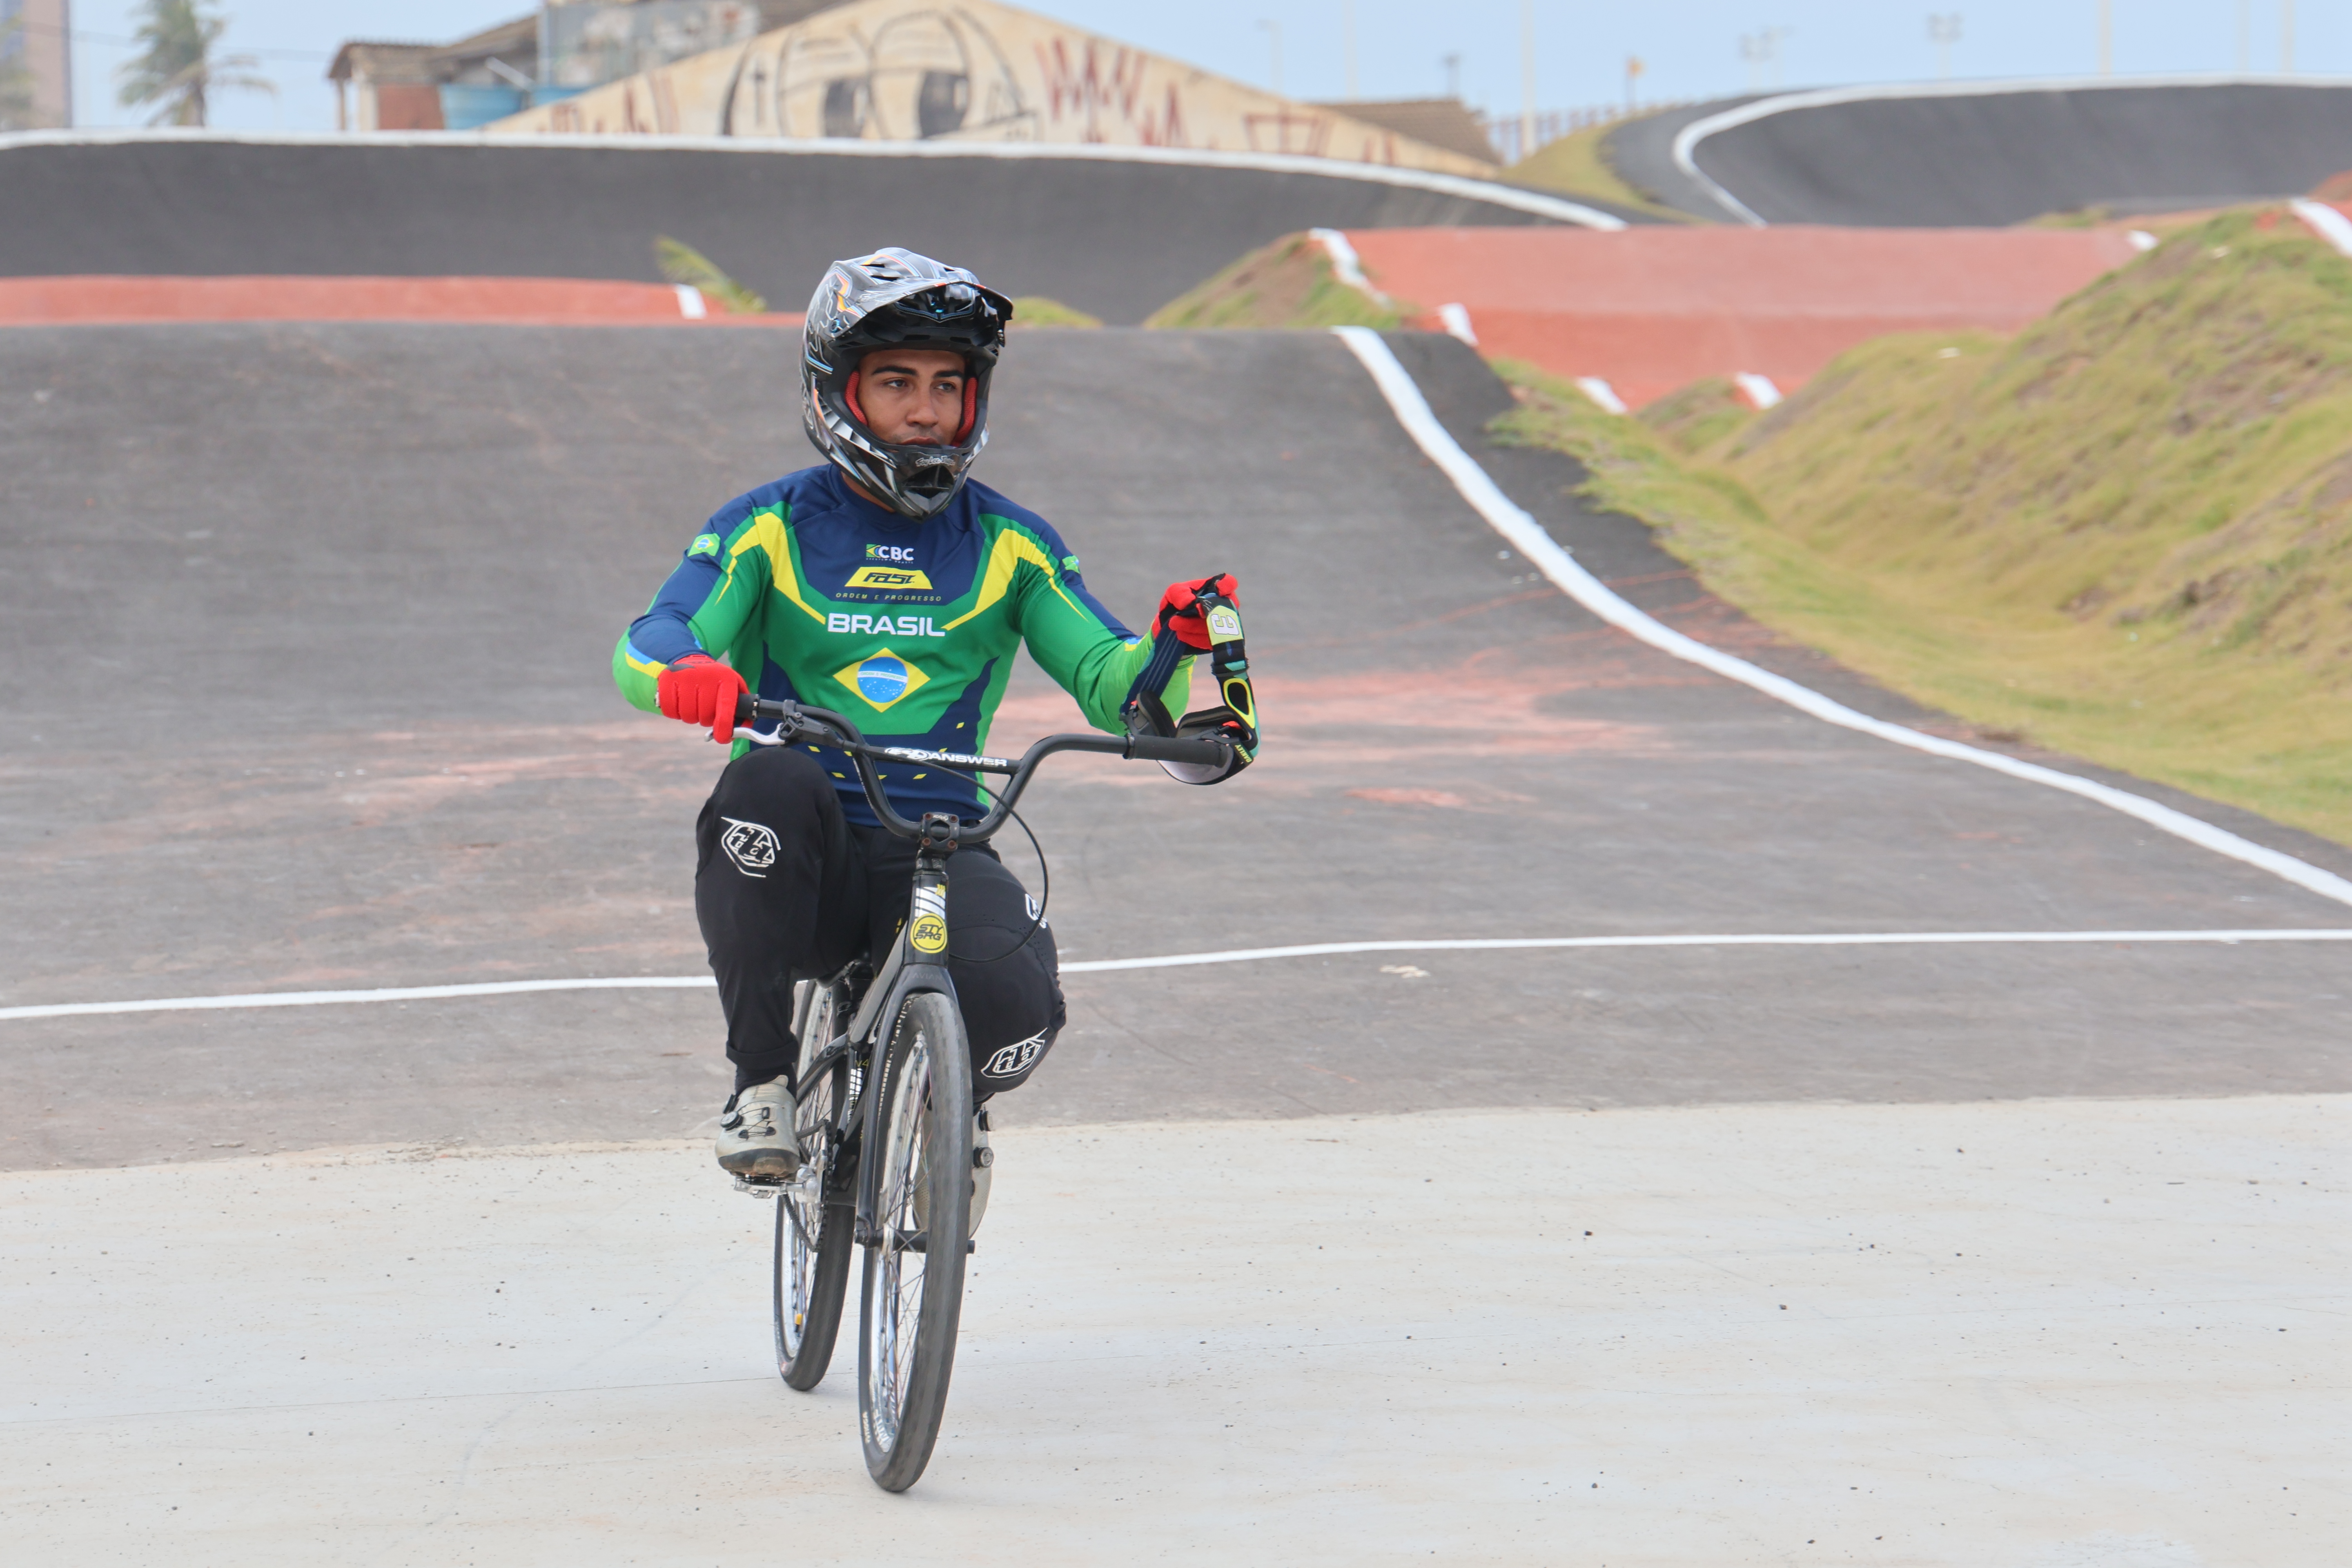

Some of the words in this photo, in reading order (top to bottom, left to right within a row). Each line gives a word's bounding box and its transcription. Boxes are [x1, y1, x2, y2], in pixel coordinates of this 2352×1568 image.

[878, 546, 915, 561] CBC
[828, 613, 946, 637] BRASIL
[927, 752, 1007, 766] ANSWER
[1234, 744, 1252, 763] OAKLEY
